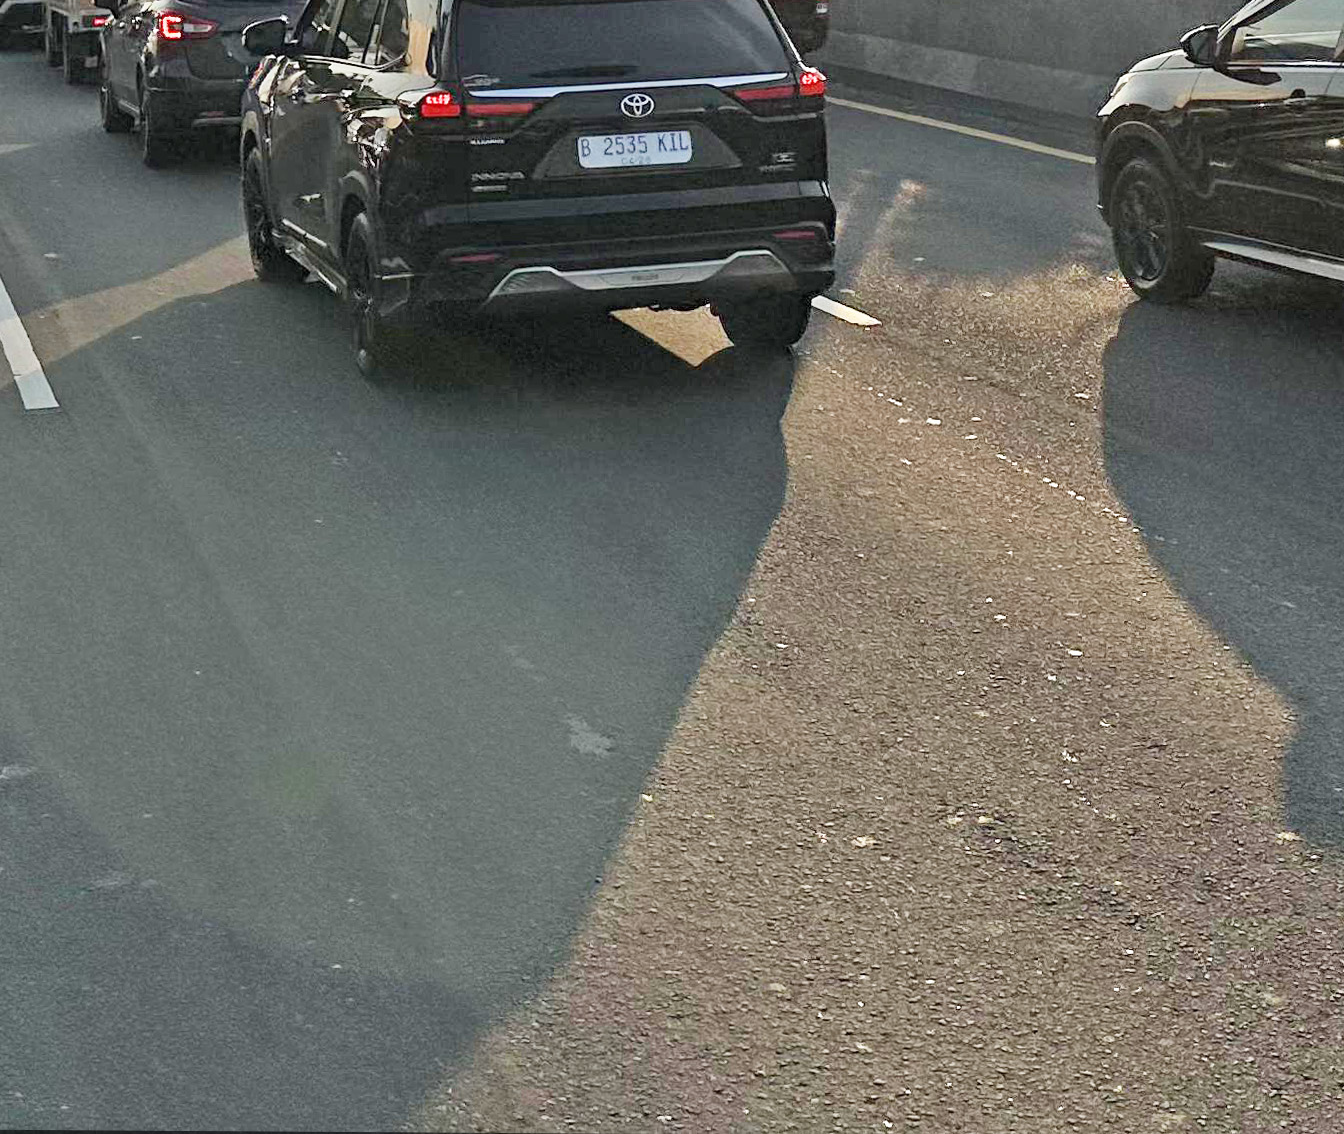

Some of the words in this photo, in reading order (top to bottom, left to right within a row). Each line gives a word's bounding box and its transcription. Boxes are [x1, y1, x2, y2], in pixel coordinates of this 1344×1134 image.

[580, 138, 592, 157] B
[603, 135, 648, 156] 2535
[657, 132, 689, 152] KIL
